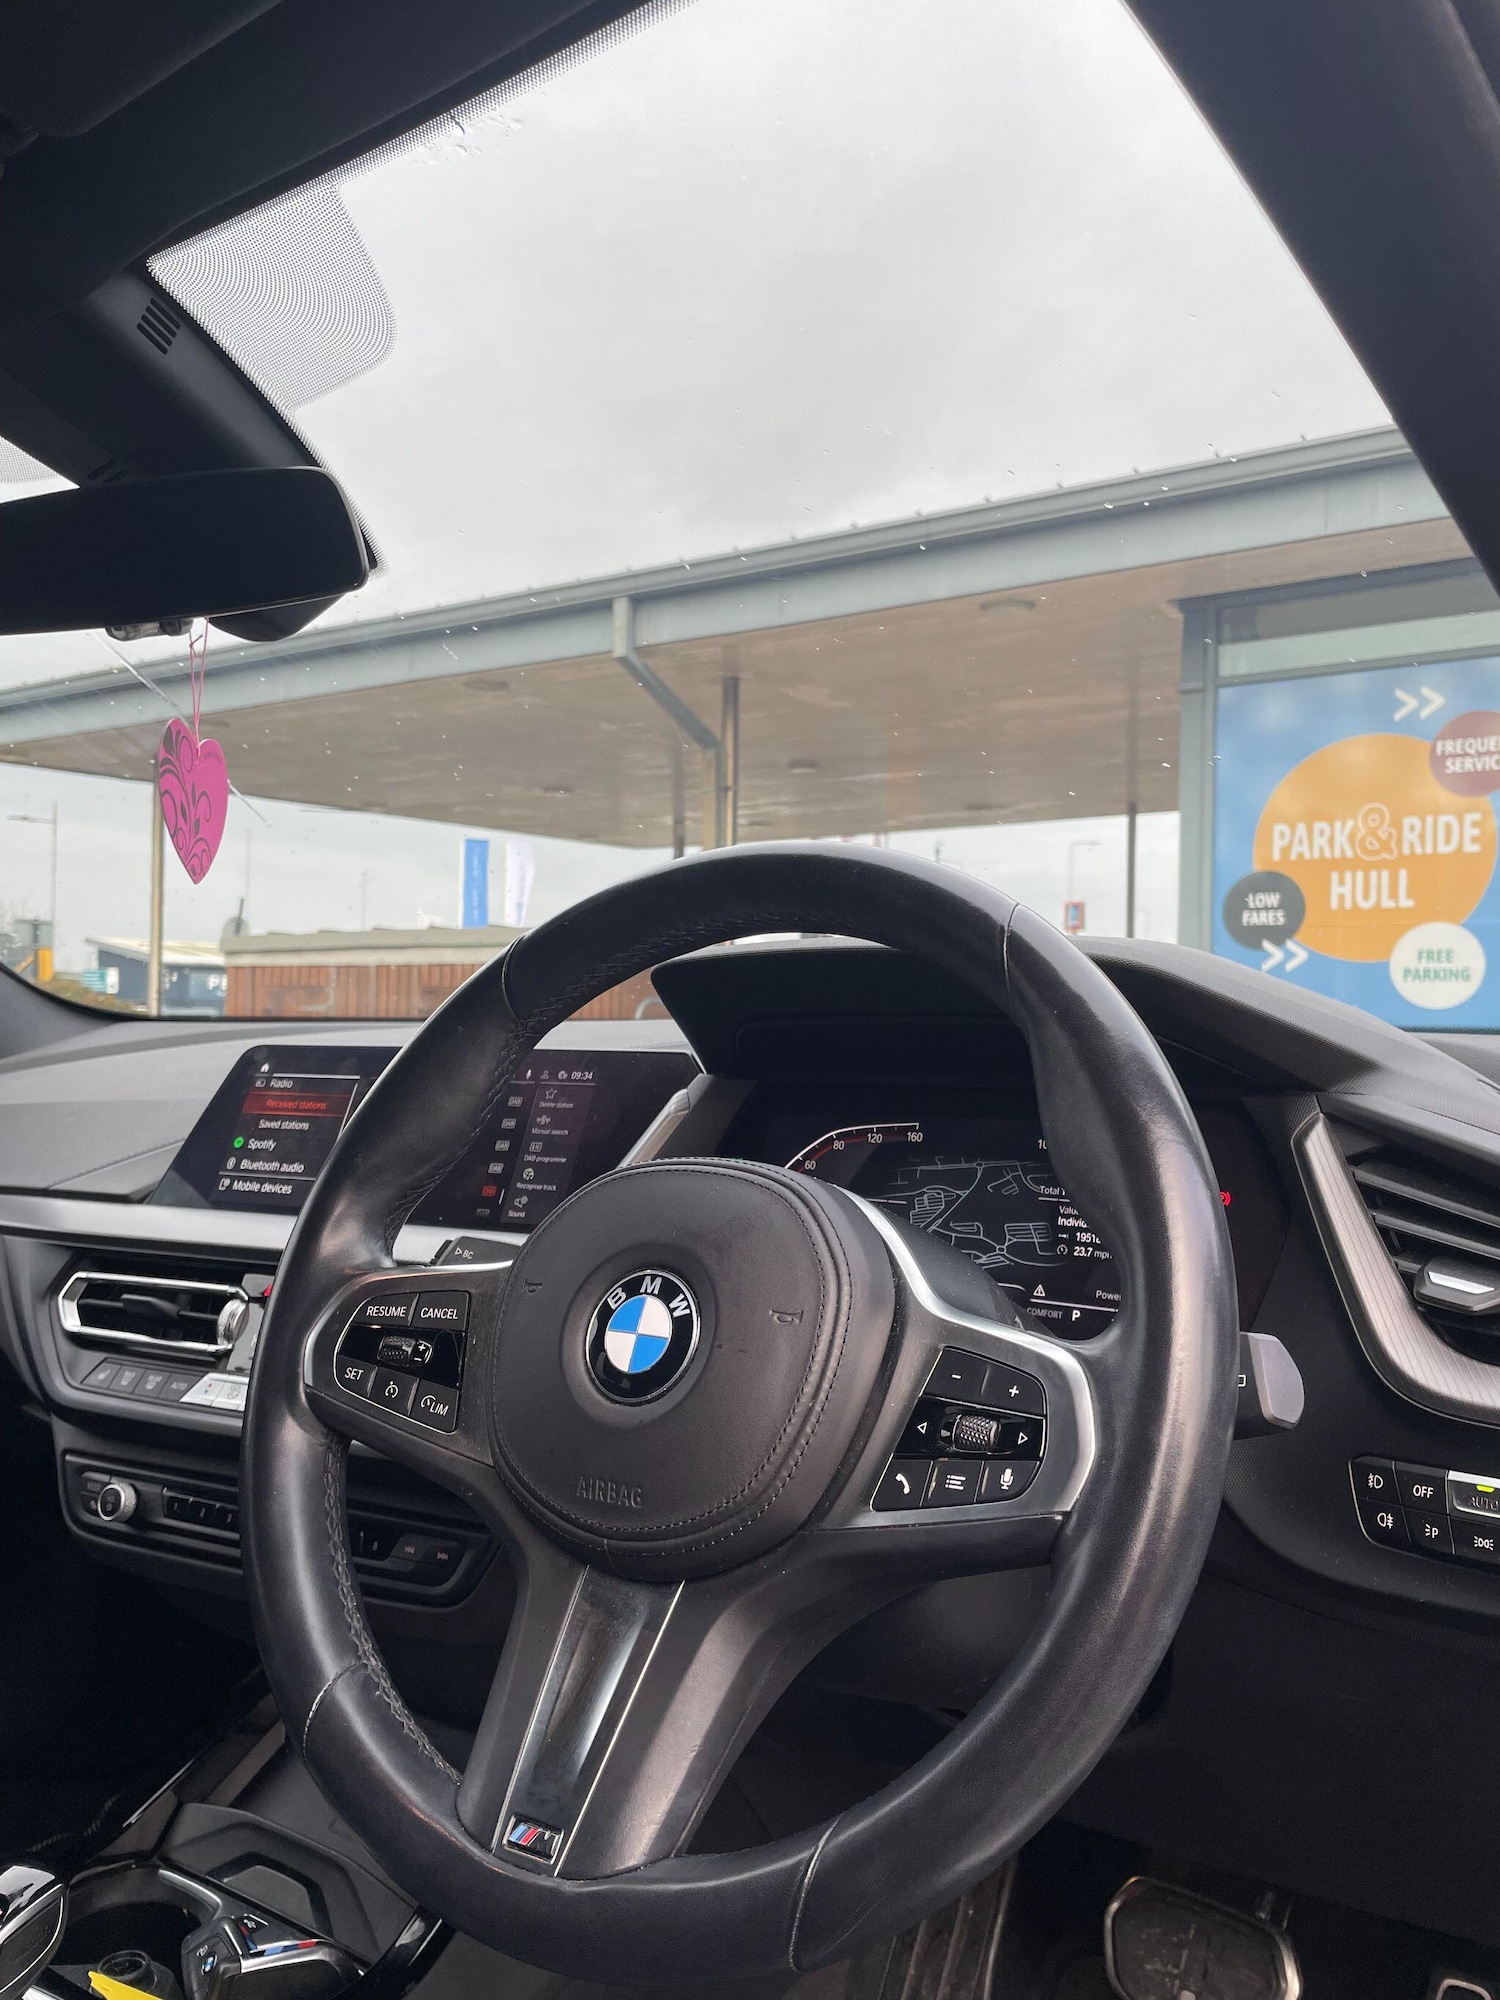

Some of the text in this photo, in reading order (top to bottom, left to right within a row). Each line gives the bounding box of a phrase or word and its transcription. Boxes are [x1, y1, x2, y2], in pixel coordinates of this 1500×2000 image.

[1330, 868, 1415, 911] HULL
[1247, 892, 1281, 909] LOW
[1242, 909, 1286, 926] FARES
[1417, 948, 1455, 964] FREE
[1403, 966, 1471, 983] PARKING
[571, 1071, 594, 1080] 09:34
[270, 1078, 293, 1089] Radio
[266, 1099, 327, 1110] Received stations
[258, 1119, 310, 1130] Saved stations
[502, 1119, 516, 1129] DAB
[531, 1127, 551, 1135] Manual
[867, 1133, 883, 1144] 120
[907, 1132, 923, 1143] 160
[248, 1138, 277, 1152] Spotify
[833, 1140, 845, 1150] 80
[536, 1156, 567, 1164] programme
[804, 1160, 816, 1170] 60
[240, 1159, 304, 1173] Bluetooth audio
[489, 1163, 503, 1174] DAB
[232, 1179, 293, 1195] Mobile devices
[516, 1182, 557, 1191] Recognise track
[1040, 1185, 1060, 1195] Total
[508, 1210, 526, 1218] Sound
[463, 1249, 474, 1260] BC
[1073, 1246, 1093, 1257] 23.7
[607, 1275, 691, 1318] BMW
[366, 1305, 407, 1318] RESUME
[420, 1307, 459, 1320] CANCEL
[1026, 1307, 1081, 1322] COMFORT P
[344, 1366, 364, 1381] SET
[429, 1401, 449, 1417] LIM
[576, 1476, 642, 1509] AIRBAG
[1413, 1484, 1434, 1499] OFF
